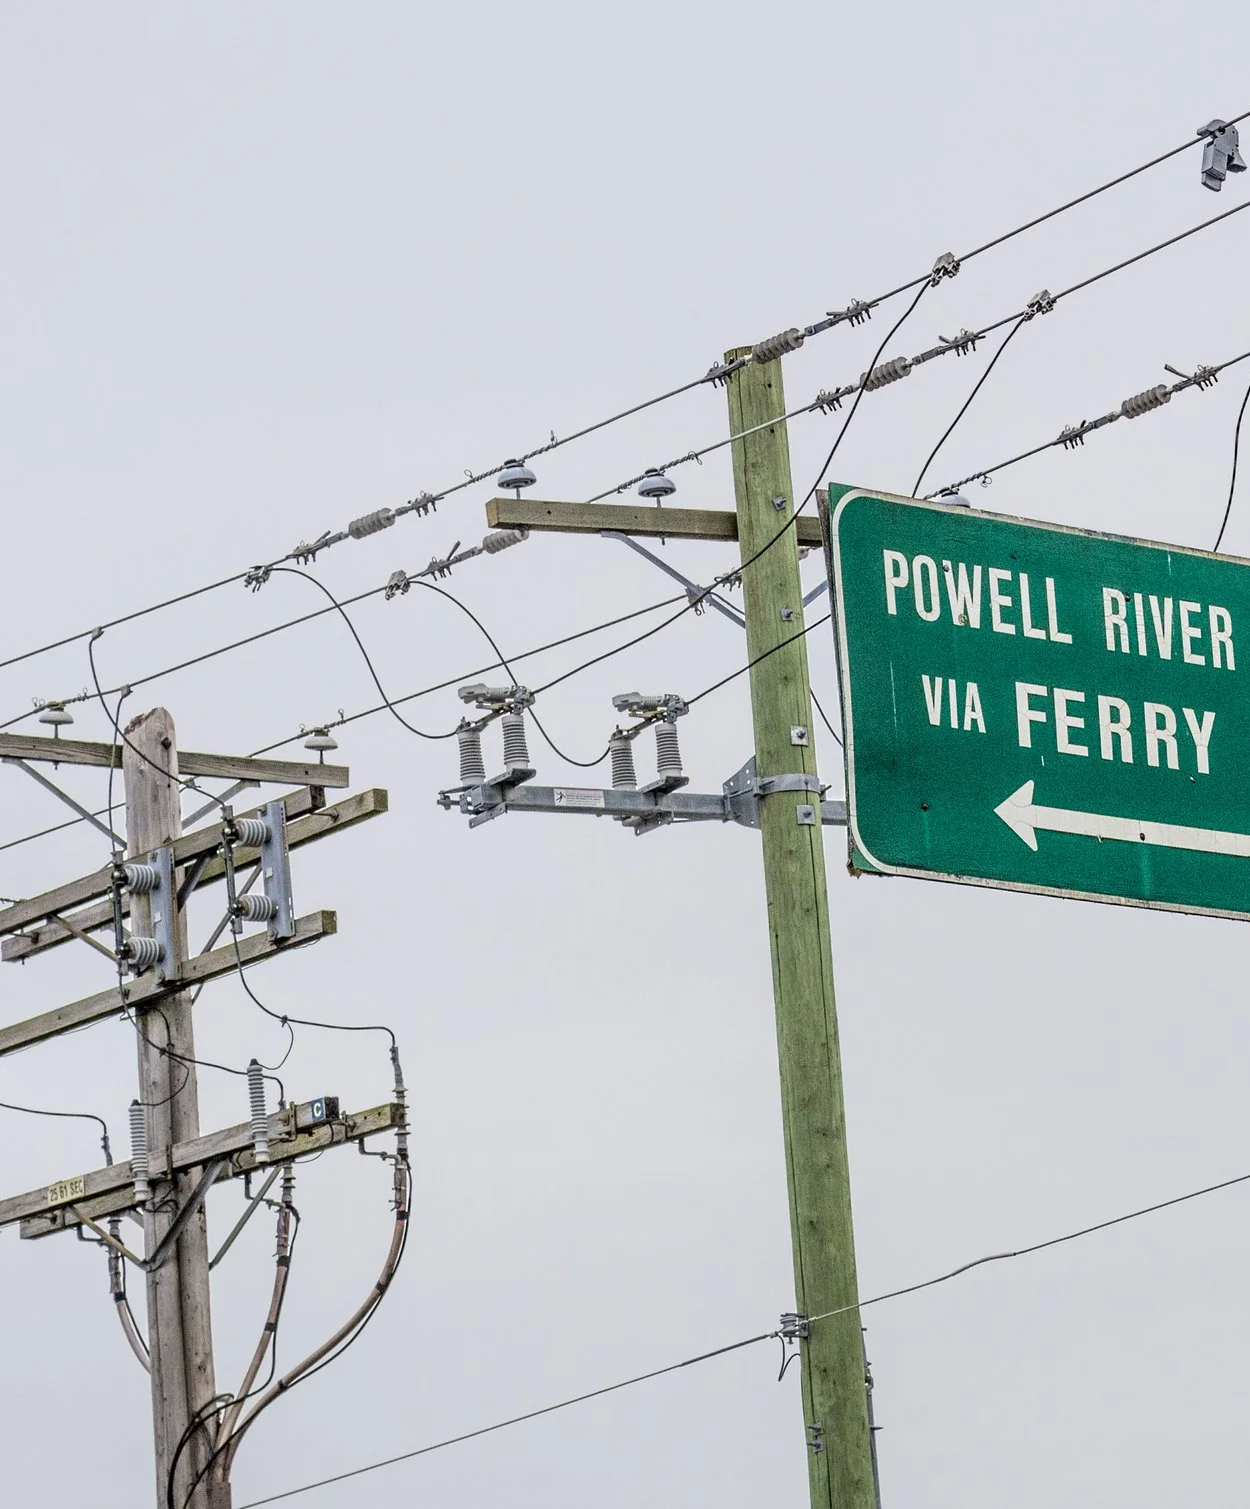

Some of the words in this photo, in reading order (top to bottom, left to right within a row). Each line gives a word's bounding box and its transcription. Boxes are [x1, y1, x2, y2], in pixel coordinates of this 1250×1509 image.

[883, 549, 1073, 645] POWELL
[1102, 587, 1236, 671] RIVER
[921, 674, 987, 734] VIA
[1015, 681, 1216, 775] FERRY
[313, 1102, 322, 1117] C
